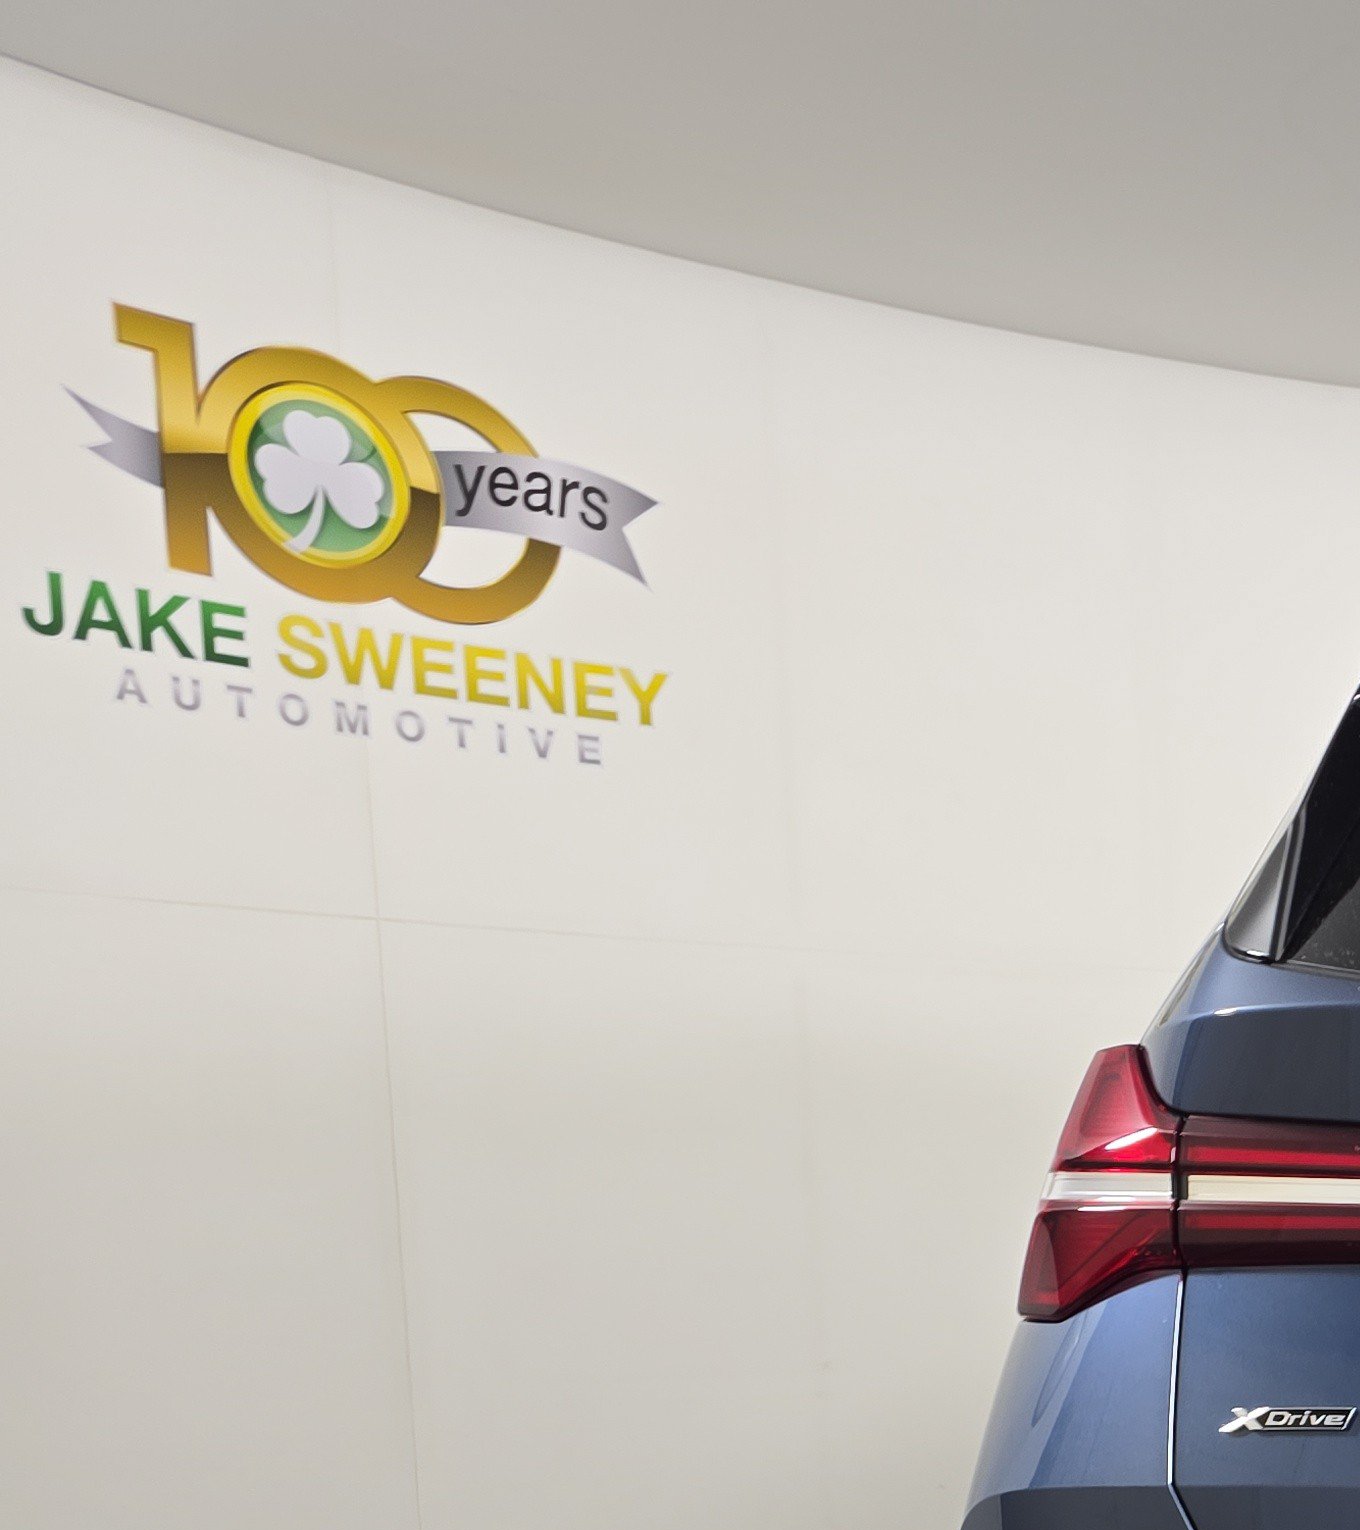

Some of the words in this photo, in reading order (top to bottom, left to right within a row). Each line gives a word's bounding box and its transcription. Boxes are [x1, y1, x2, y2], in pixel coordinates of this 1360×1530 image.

[112, 301, 562, 625] 100
[453, 459, 610, 532] years
[22, 571, 250, 668] JAKE
[276, 614, 669, 727] SWEENEY
[115, 668, 603, 765] AUTOMOTIVE
